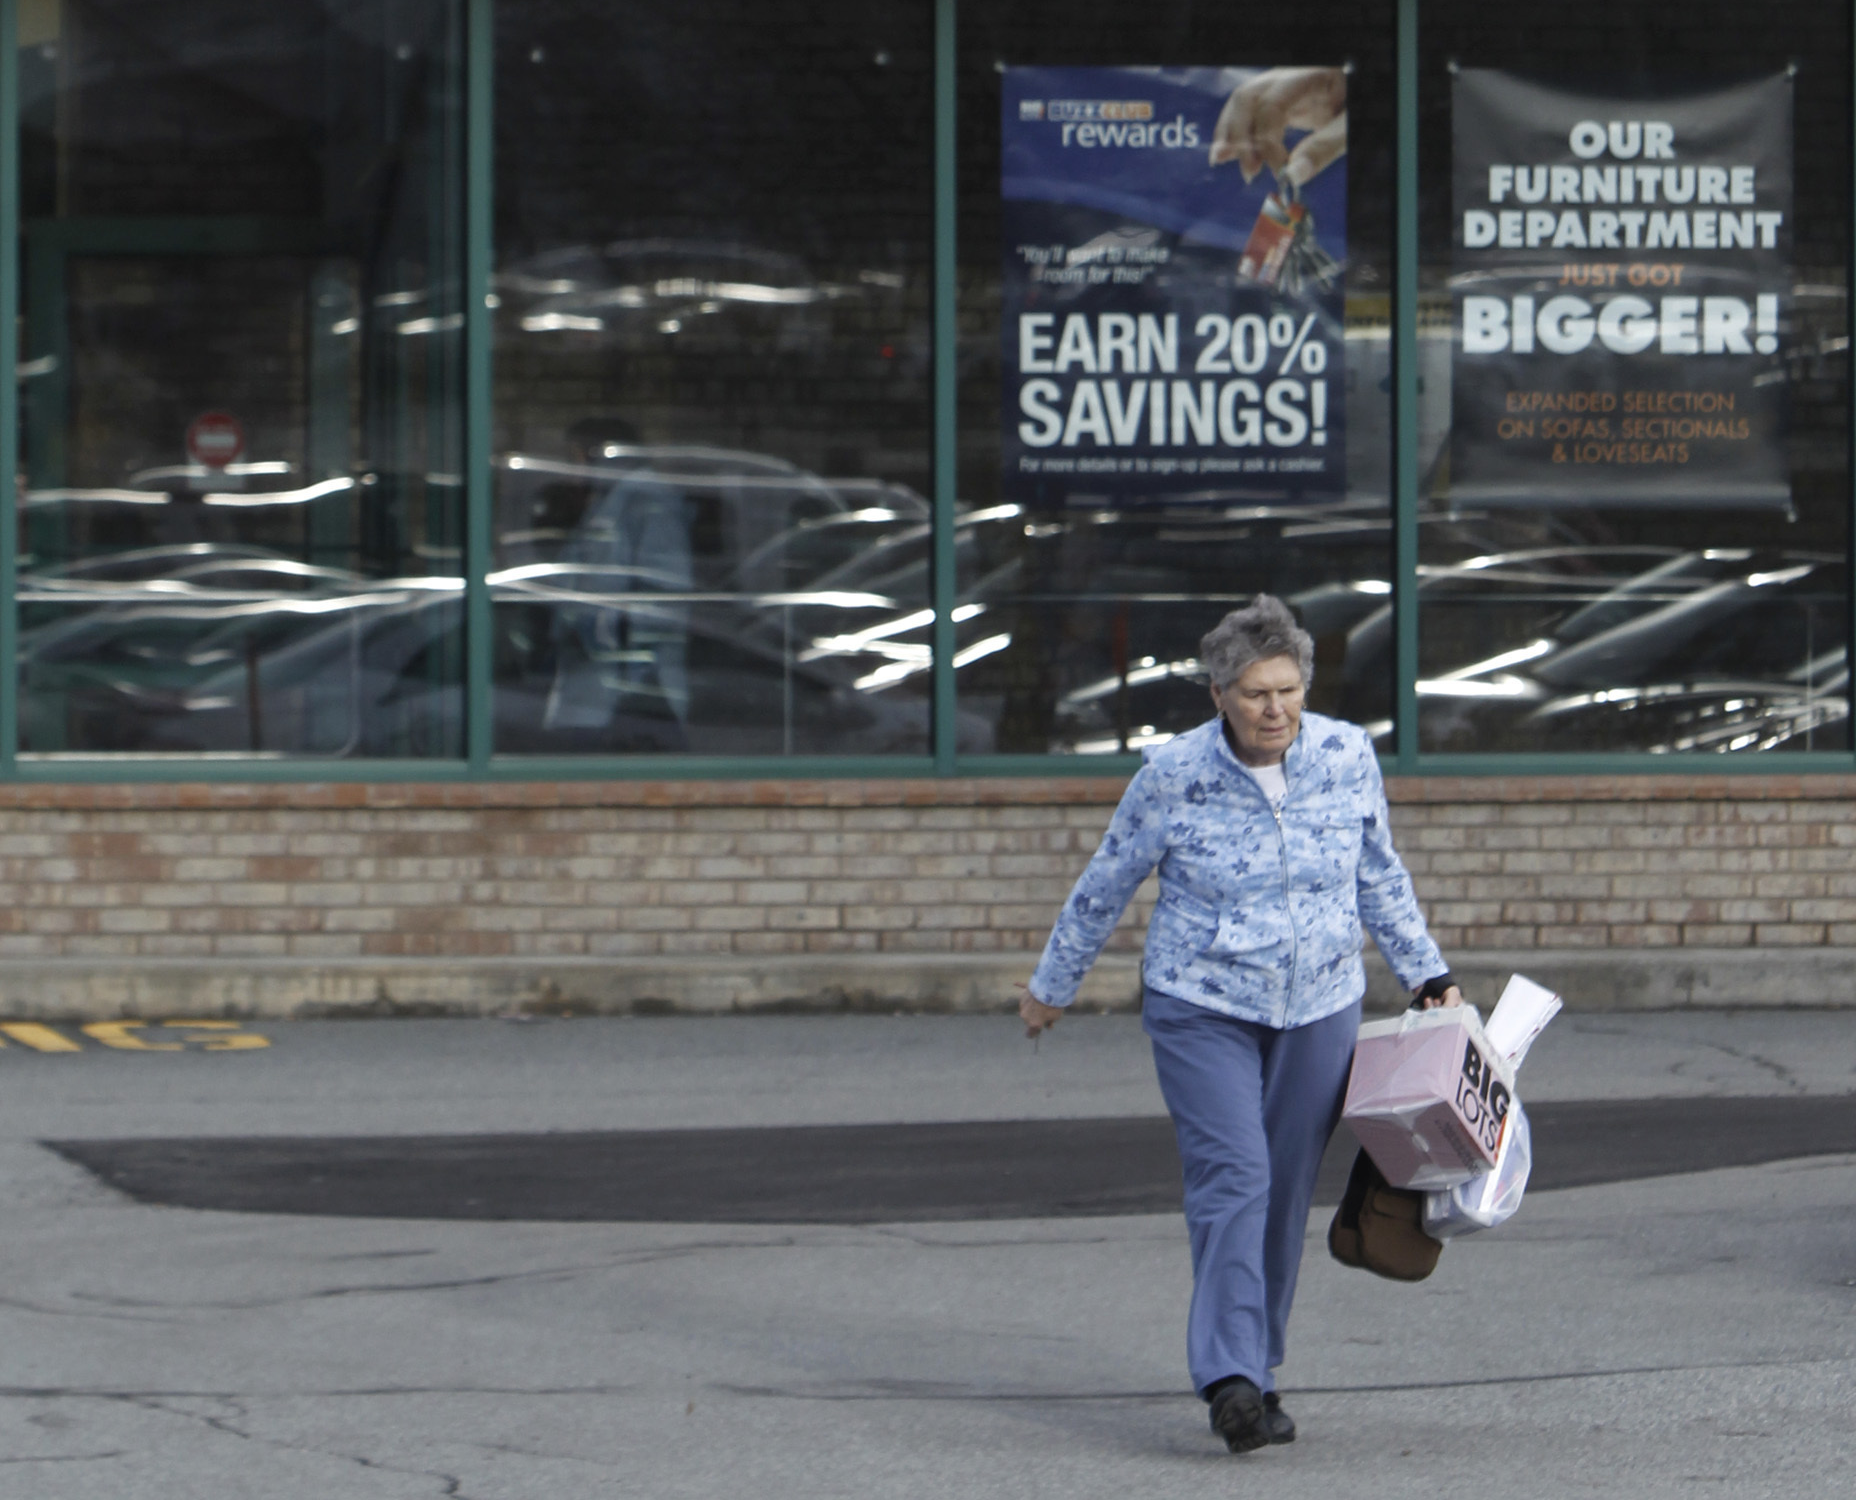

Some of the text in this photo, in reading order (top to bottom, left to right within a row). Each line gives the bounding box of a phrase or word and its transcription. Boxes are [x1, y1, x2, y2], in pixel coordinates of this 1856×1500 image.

[1061, 114, 1199, 149] rewards
[1569, 120, 1675, 160] OUR
[1489, 165, 1755, 205] FURNITURE
[1463, 209, 1783, 249] DEPARTMENT
[1559, 262, 1685, 287] JUST GOT
[1018, 312, 1328, 376] EARN 20%
[1462, 293, 1779, 355] BIGGER!
[1018, 379, 1328, 448] SAVINGS!
[1506, 391, 1736, 413] EXPANDED SELECTION
[1496, 417, 1750, 444] ON SOFAS, SECTIONALS
[1552, 442, 1690, 465] & LOVESEATS
[1462, 1037, 1510, 1125] BIG
